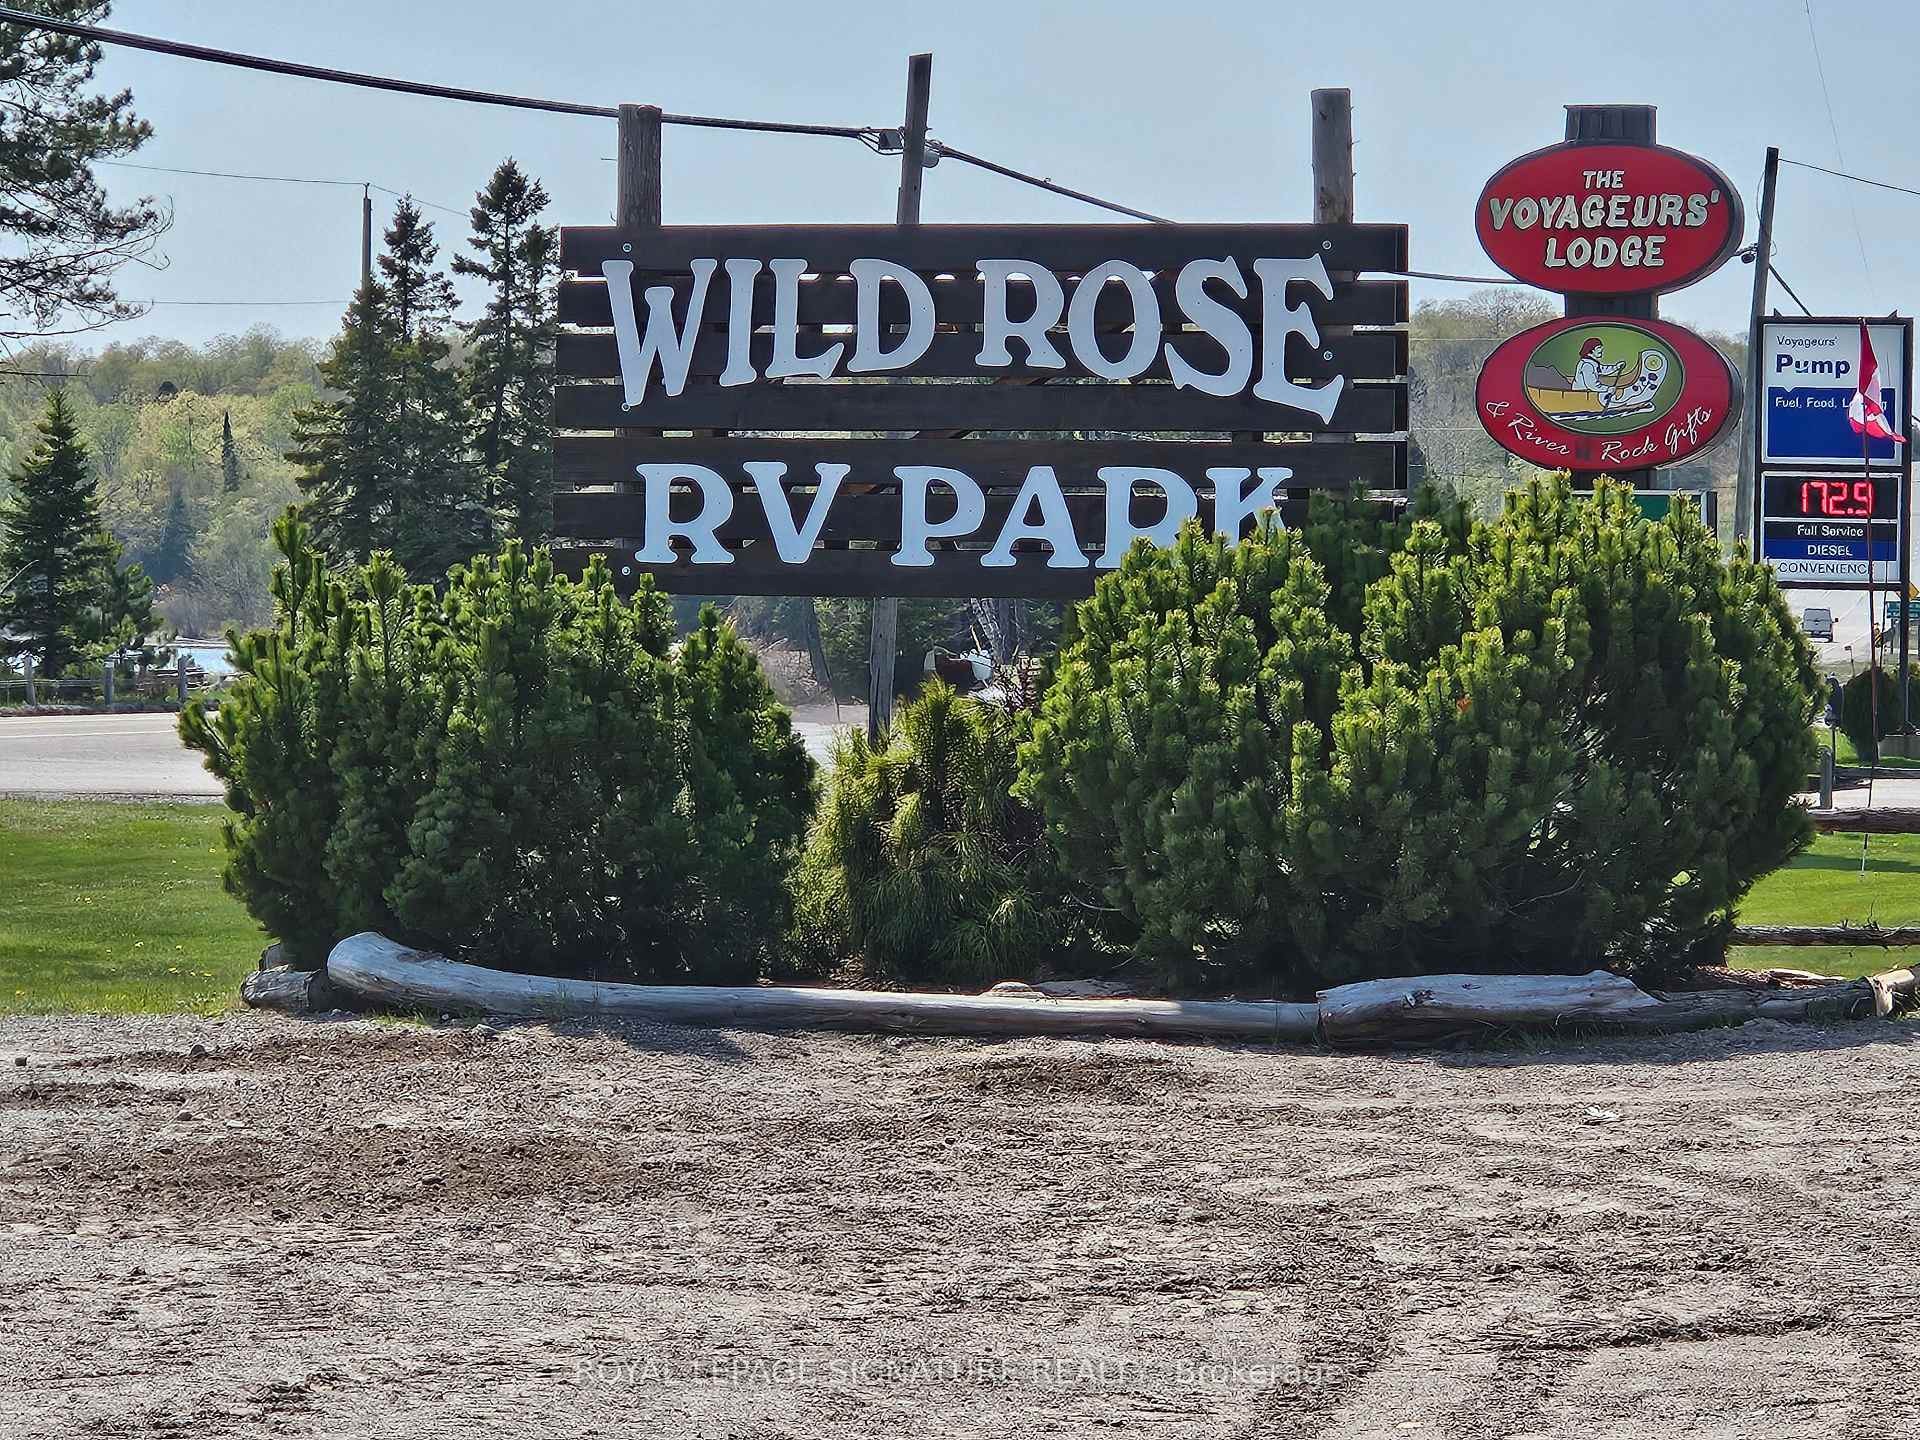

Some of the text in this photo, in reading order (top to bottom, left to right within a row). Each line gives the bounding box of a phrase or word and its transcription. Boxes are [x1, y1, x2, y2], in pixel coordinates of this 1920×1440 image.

[1583, 170, 1625, 189] THE
[1489, 190, 1720, 230] VOYAGEURS'
[1544, 236, 1667, 268] LODGE
[602, 252, 1344, 425] WILD ROSE
[1776, 354, 1850, 379] Pump
[1486, 401, 1712, 463] & River Rock Gifts
[1802, 482, 1872, 514] 172.9
[634, 461, 1293, 569] RV PARK
[1797, 525, 1864, 537] Full Service
[1807, 544, 1853, 556] DIESEL
